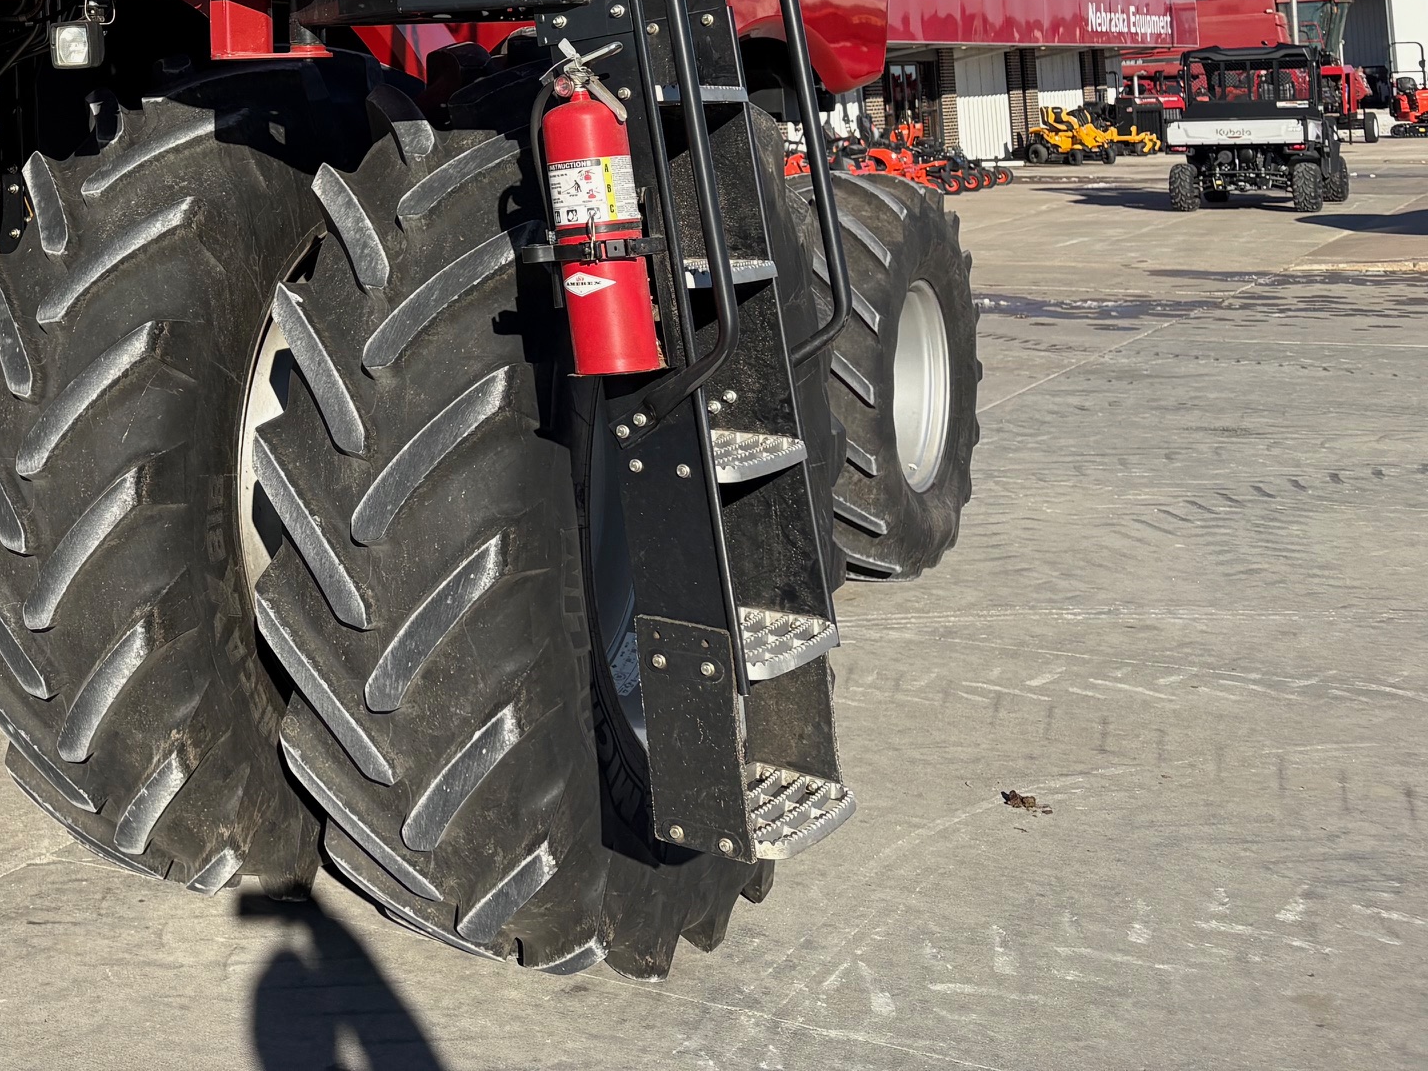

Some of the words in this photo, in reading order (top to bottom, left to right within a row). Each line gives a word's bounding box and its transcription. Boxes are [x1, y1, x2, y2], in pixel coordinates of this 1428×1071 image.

[1088, 2, 1128, 33] Nebraska
[1129, 5, 1172, 42] Equipment
[1215, 128, 1252, 137] Kubota
[604, 163, 610, 173] A
[606, 184, 612, 193] B
[609, 204, 615, 213] C
